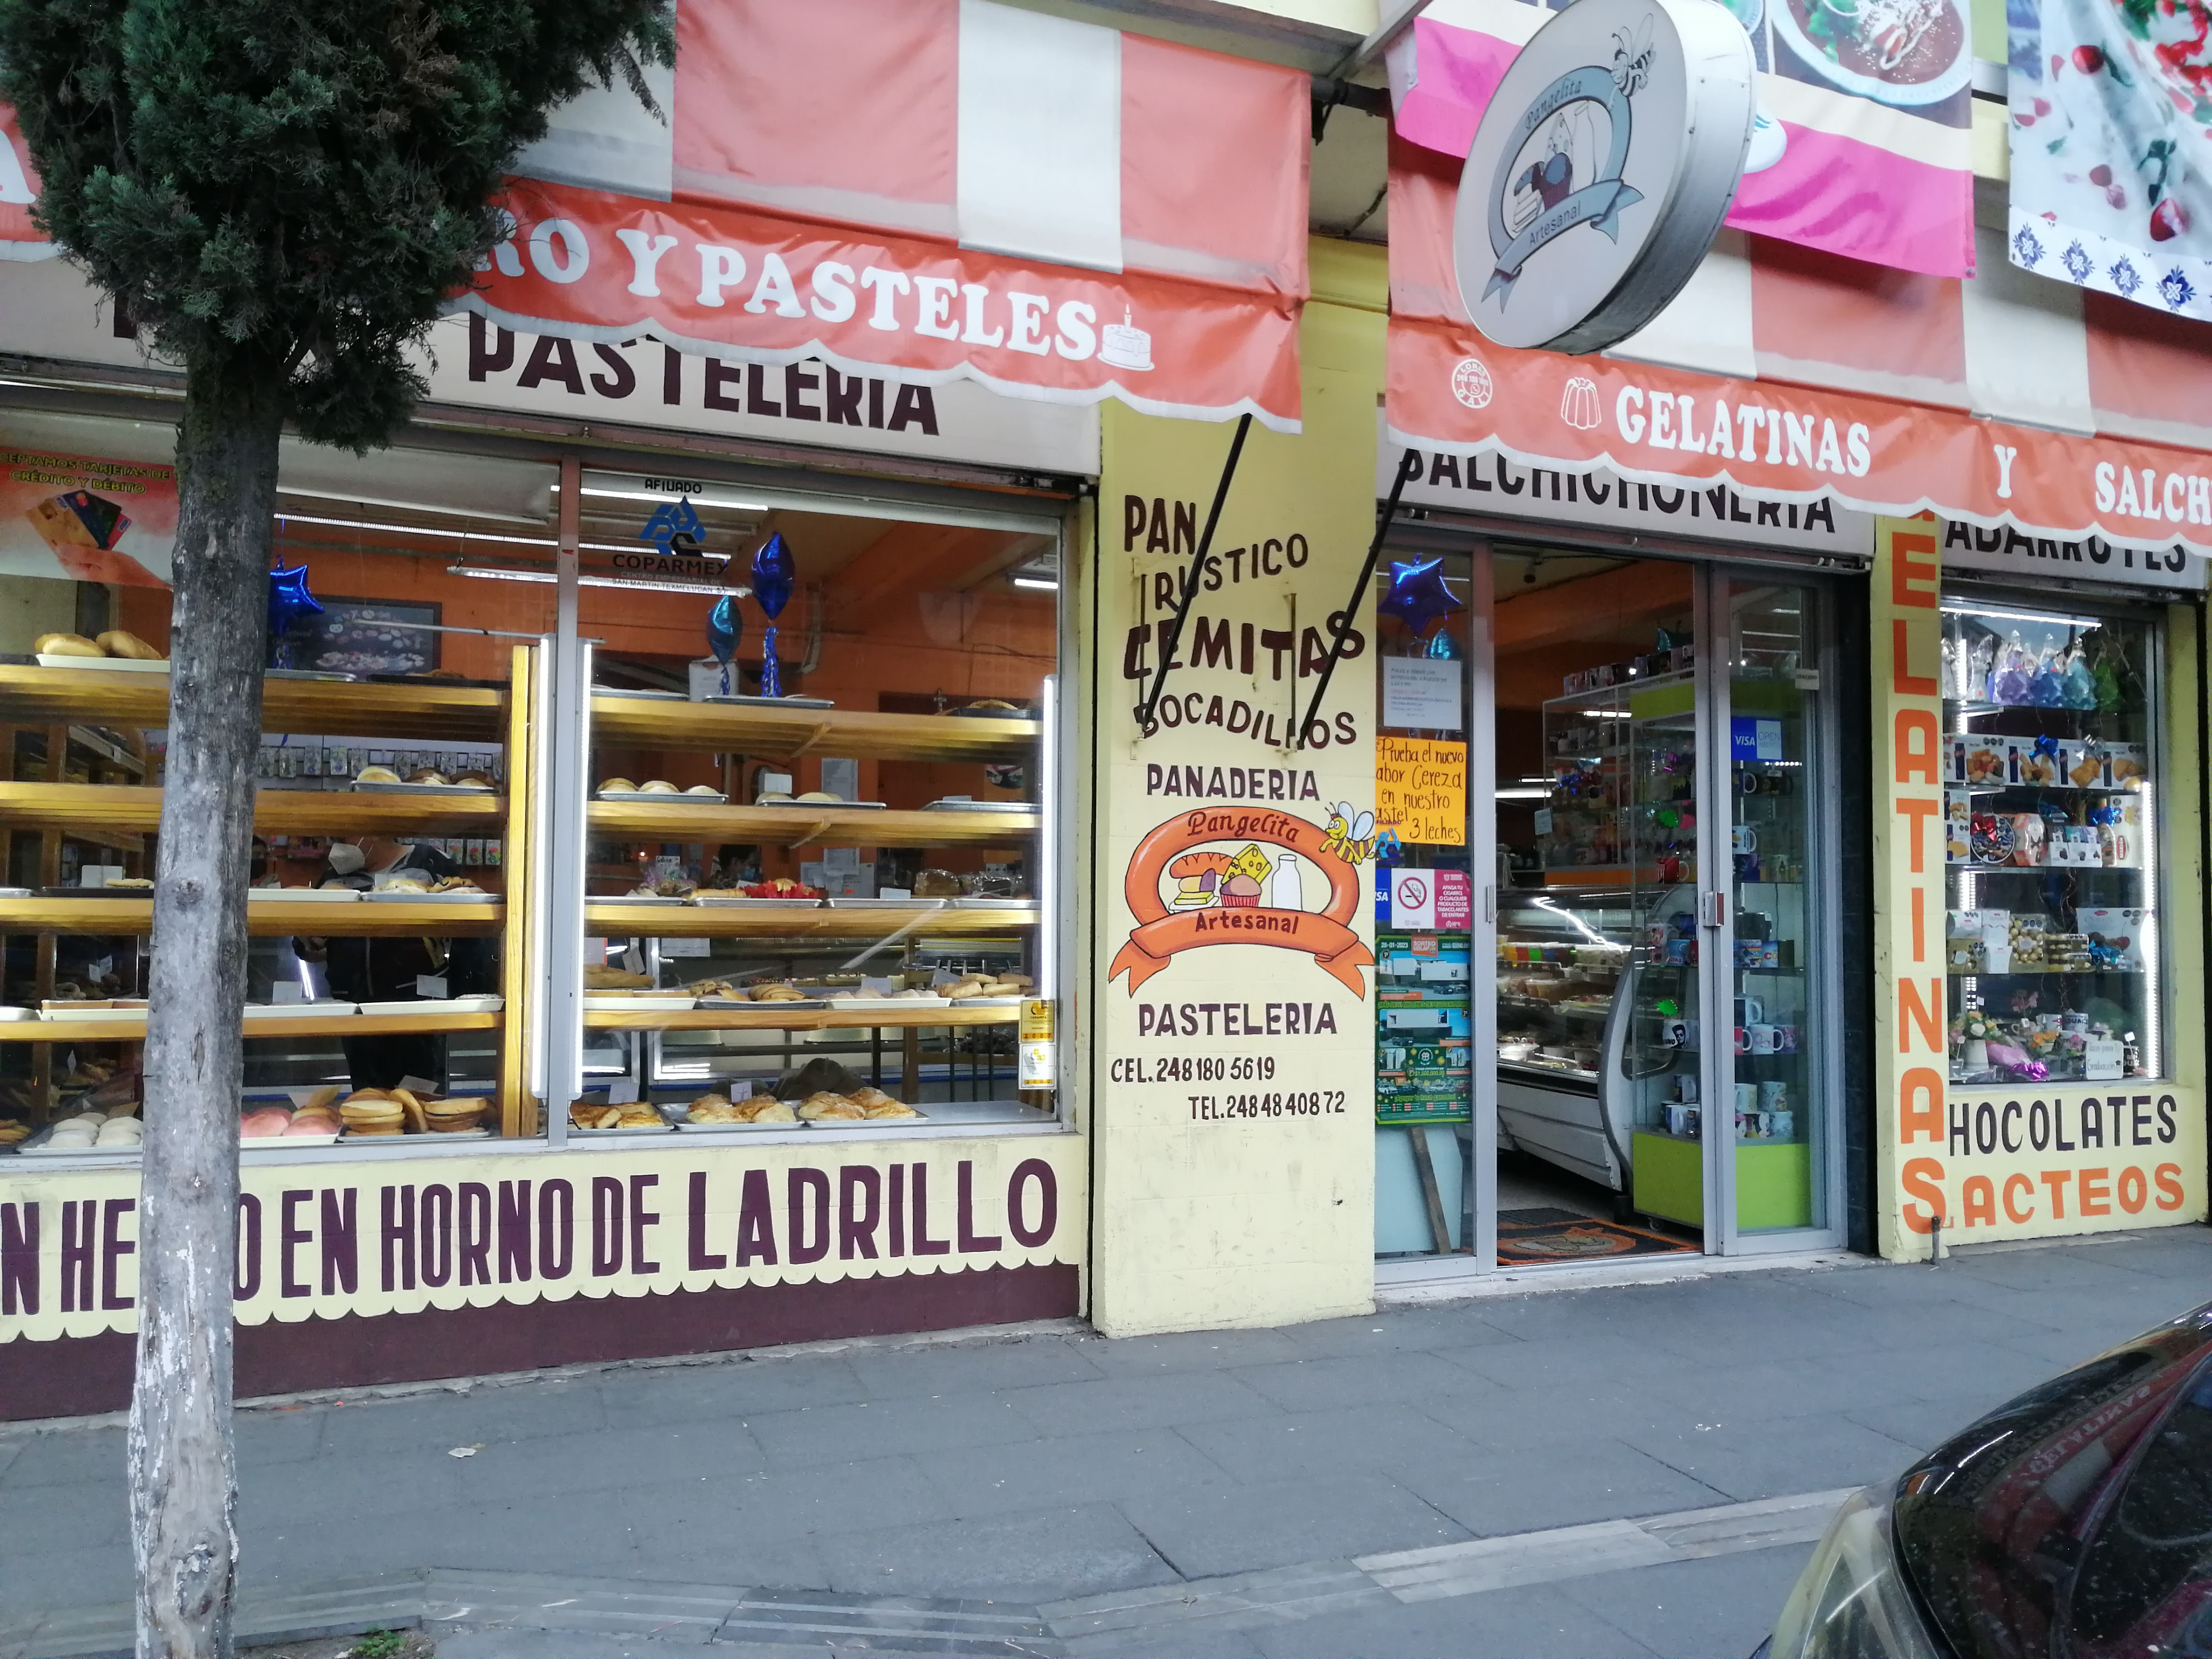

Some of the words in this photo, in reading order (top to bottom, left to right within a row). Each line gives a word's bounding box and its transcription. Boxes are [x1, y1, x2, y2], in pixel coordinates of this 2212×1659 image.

[1530, 200, 1581, 247] Artesanal
[616, 229, 678, 298] Y
[695, 243, 1097, 360] PASTELES
[1616, 385, 1871, 478] GELATINAS
[1994, 444, 2017, 499] Y
[10, 469, 76, 486] CRÉDITO
[77, 477, 89, 488] Y
[92, 478, 147, 494] DÉBITO
[81, 461, 149, 477] TARJETAS
[150, 469, 171, 480] DE
[1124, 495, 1196, 555] PAN
[612, 554, 728, 576] COPARMEX
[1124, 611, 1365, 681] CEMITAS
[1735, 735, 1755, 746] VISA
[1758, 732, 1781, 741] OPEN
[1422, 742, 1431, 762] el
[1435, 751, 1464, 765] nuevo
[1147, 763, 1320, 801] PANADERIA
[1376, 762, 1406, 783] abor
[1412, 765, 1463, 790] Cereza
[1381, 788, 1394, 805] en
[1404, 789, 1450, 810] nuestro
[1187, 811, 1300, 842] Pangelita
[1375, 806, 1408, 822] astel
[1409, 818, 1421, 839] 3
[1891, 509, 1947, 1235] ELATINAS
[1375, 891, 1389, 902] SA
[1195, 911, 1299, 934] Artesanal
[1139, 1002, 1337, 1037] PASTELERIA
[1230, 1056, 1276, 1081] 5619
[1949, 1094, 2177, 1157] HOCOLATES
[1949, 1162, 2185, 1229] ACTEOS
[60, 1193, 262, 1312] HEO
[281, 1188, 359, 1299] EN
[381, 1178, 574, 1292] HORNO
[592, 1174, 660, 1277] DE
[688, 1158, 1058, 1272] LADRILLO
